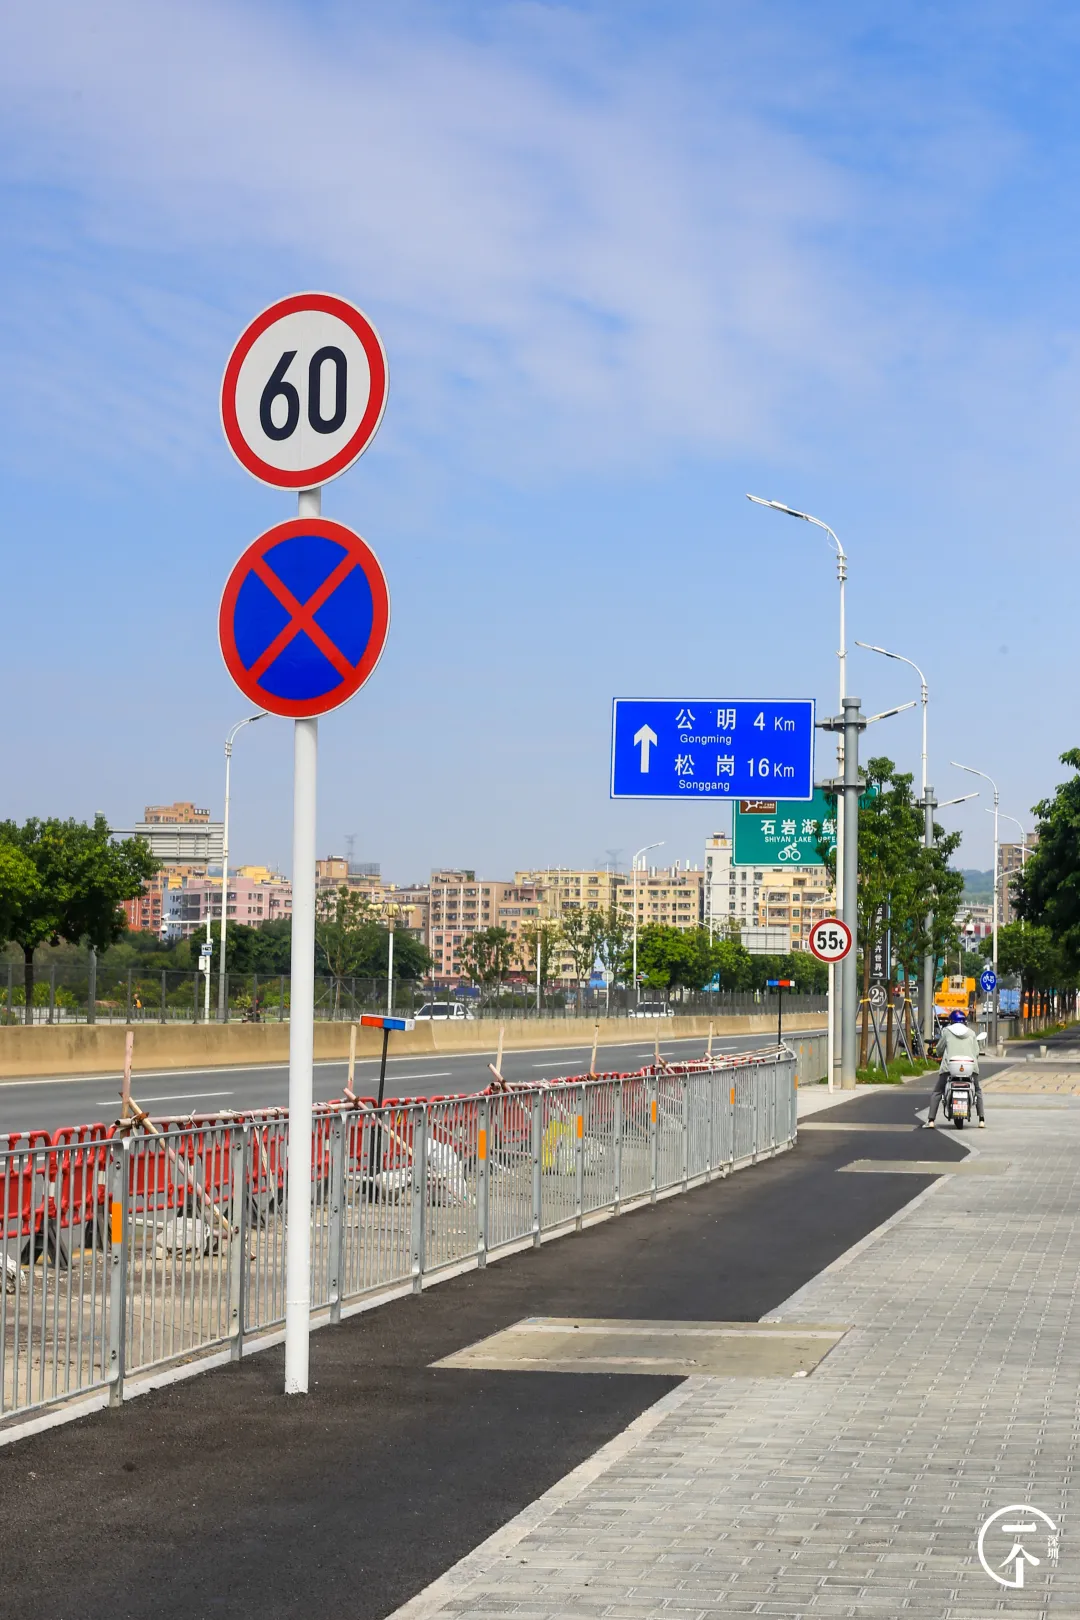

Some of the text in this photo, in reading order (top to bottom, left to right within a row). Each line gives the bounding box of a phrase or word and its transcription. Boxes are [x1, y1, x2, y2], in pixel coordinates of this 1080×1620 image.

[259, 345, 348, 442] 60
[675, 708, 796, 732] 公明 4 Km
[679, 733, 732, 746] Gongming
[674, 753, 796, 778] 松岗 16 Km
[678, 779, 730, 792] Songgang
[764, 835, 791, 844] SHIYAN
[794, 835, 812, 844] LAKE
[817, 930, 844, 950] 55t
